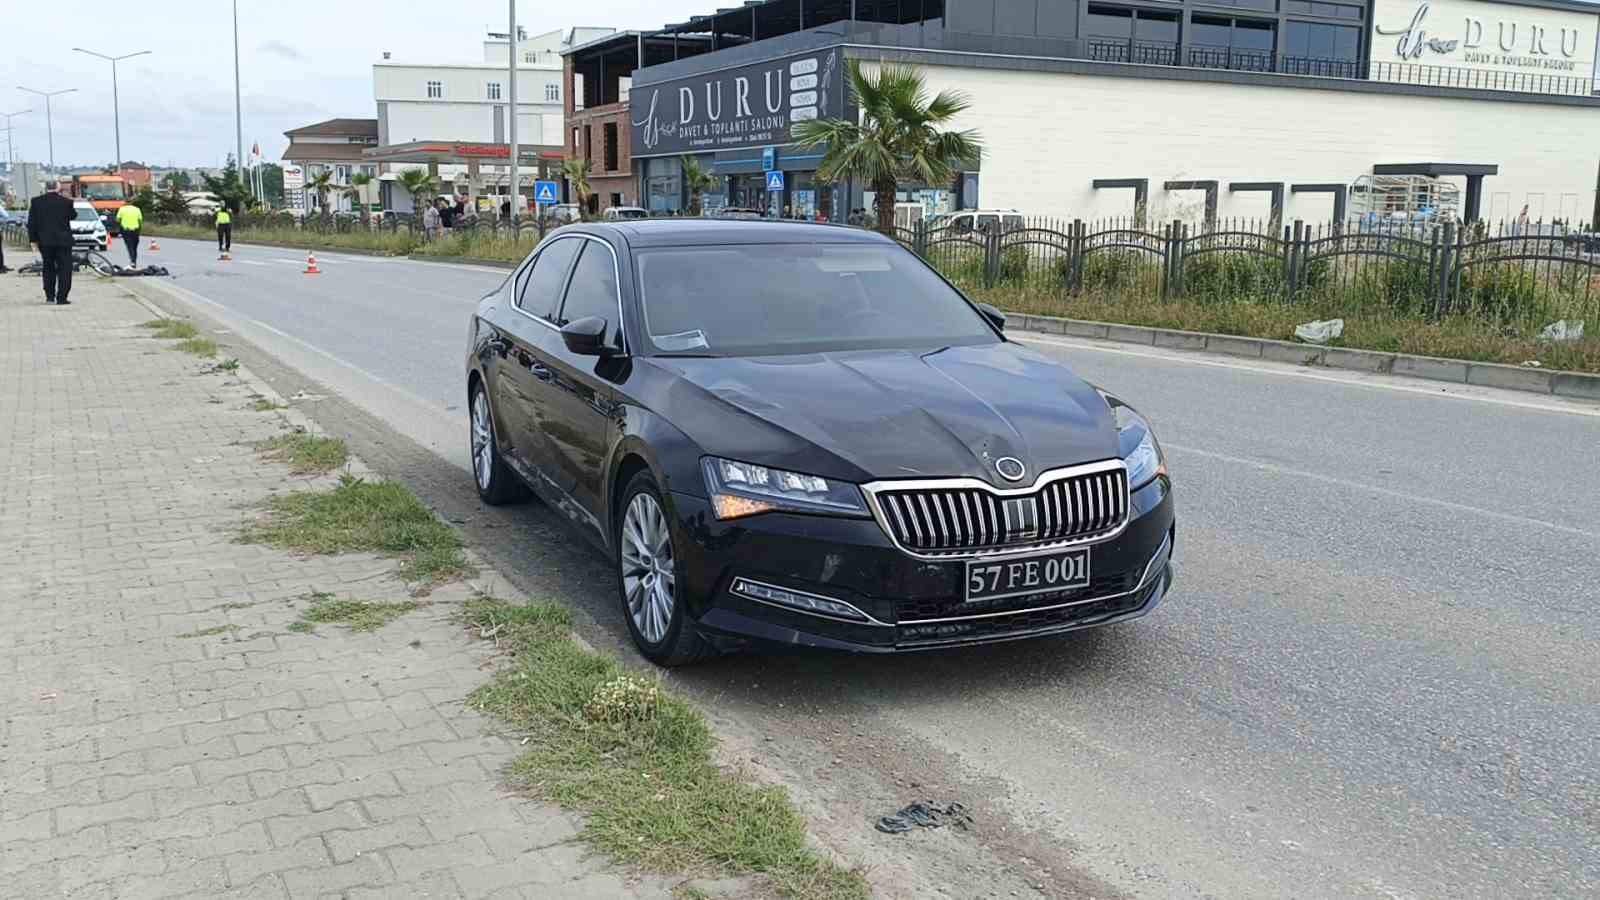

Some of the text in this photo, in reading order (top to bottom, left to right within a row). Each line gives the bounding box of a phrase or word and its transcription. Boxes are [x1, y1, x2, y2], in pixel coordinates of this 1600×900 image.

[1464, 17, 1578, 58] DURU
[679, 69, 784, 125] DURU
[679, 125, 701, 139] DAVET
[703, 123, 709, 136] &
[711, 119, 748, 136] TOPLANTI
[751, 115, 784, 131] SALONU
[970, 555, 1085, 593] 57 FE 001
